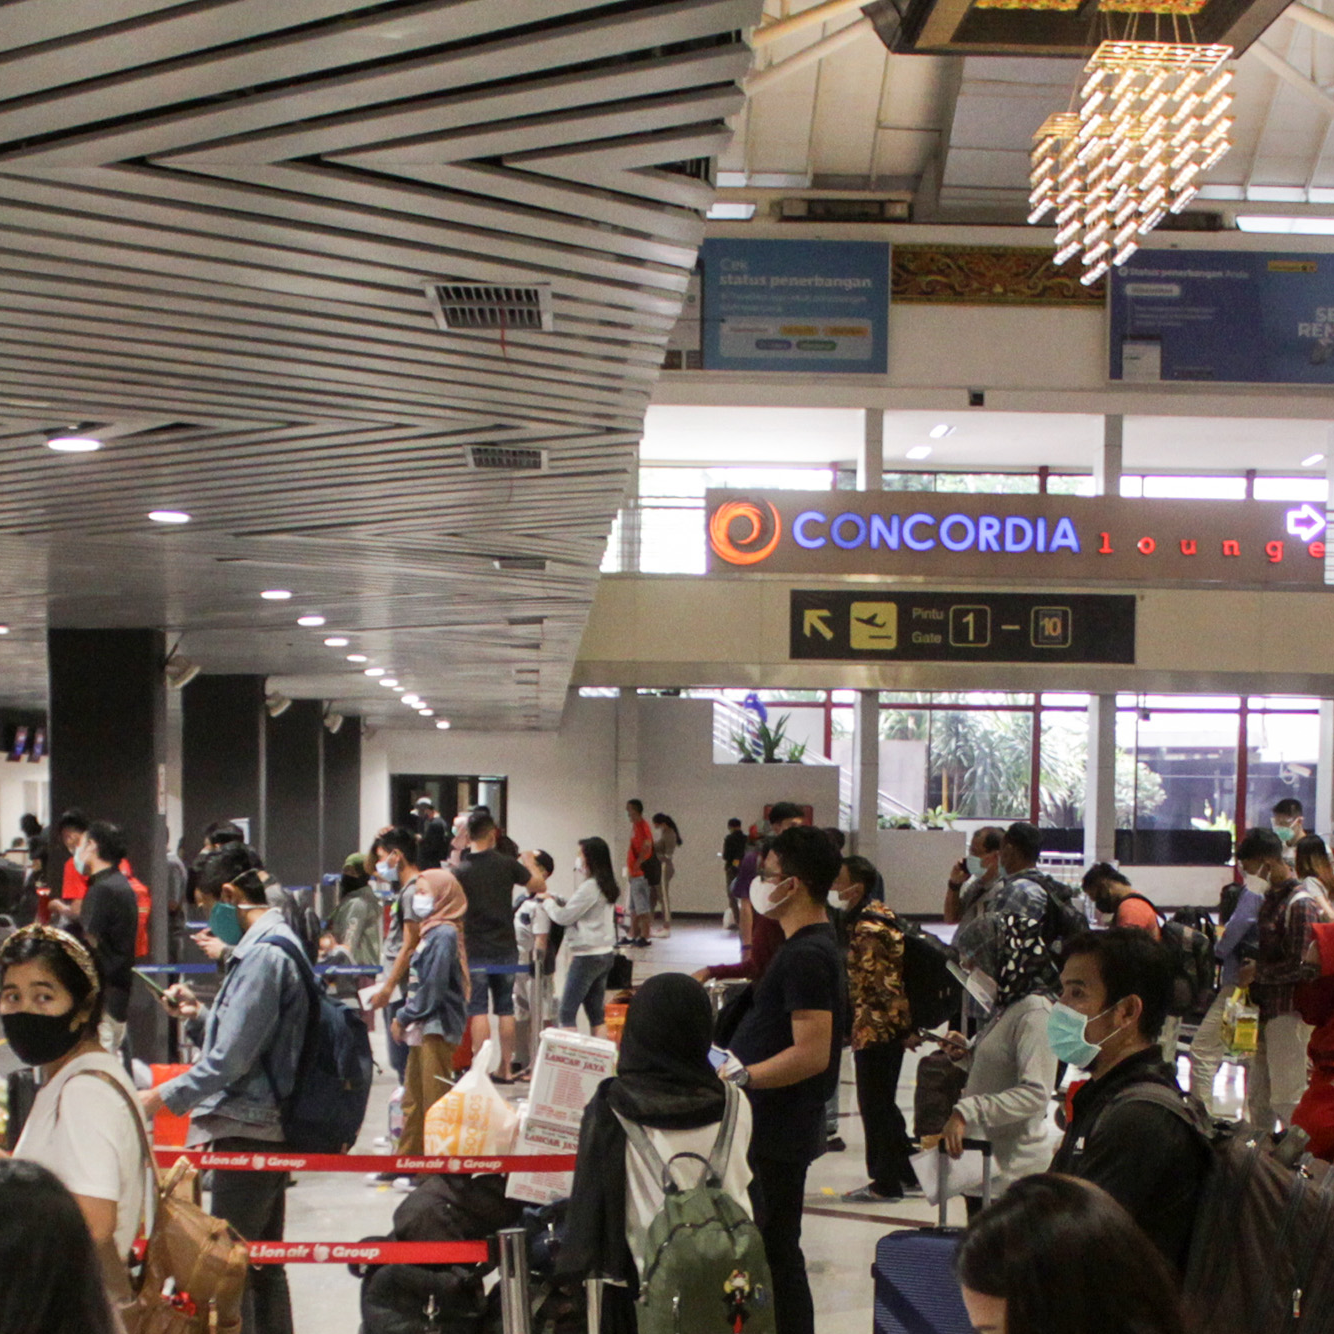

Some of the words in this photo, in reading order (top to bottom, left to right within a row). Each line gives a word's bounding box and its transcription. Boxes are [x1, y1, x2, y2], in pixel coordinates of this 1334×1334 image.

[719, 273, 767, 286] status
[770, 275, 872, 291] penerbangan
[791, 510, 1081, 553] CONCORDIA
[912, 607, 945, 621] Pintu
[962, 611, 975, 641] 1
[1039, 617, 1062, 637] 10
[911, 631, 942, 644] Gate
[200, 1154, 230, 1166] Lion
[230, 1155, 249, 1166] air
[267, 1157, 306, 1169] Group
[396, 1158, 424, 1168] Lion
[425, 1158, 445, 1169] air
[463, 1159, 502, 1170] Group
[249, 1245, 286, 1258] Lion
[287, 1245, 309, 1258] air
[332, 1246, 380, 1260] Group
